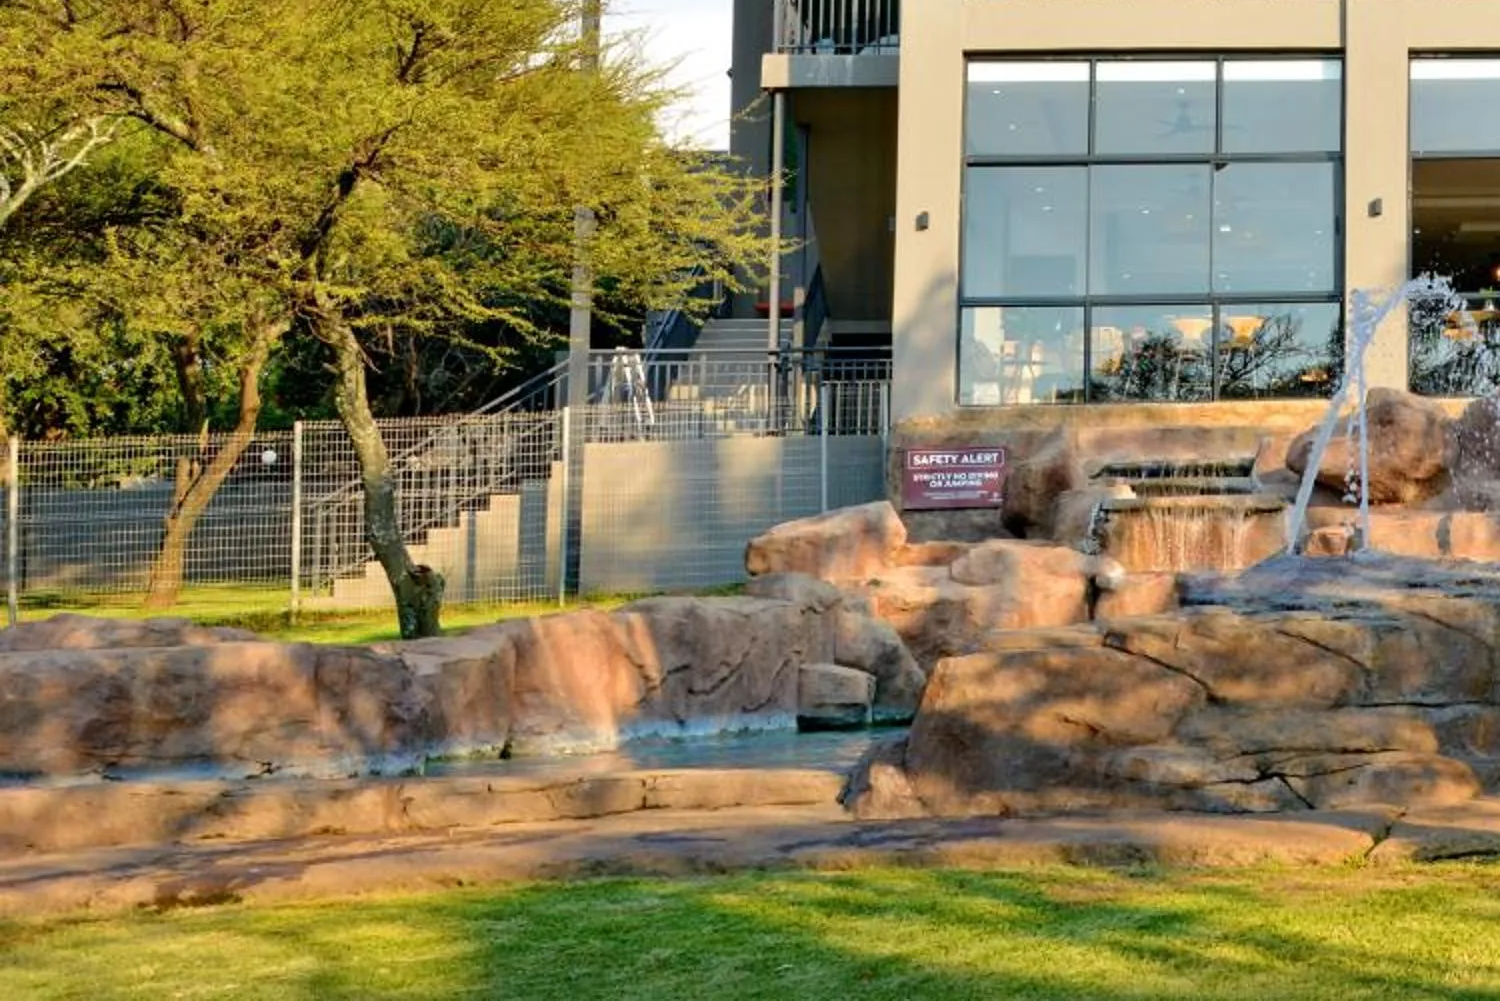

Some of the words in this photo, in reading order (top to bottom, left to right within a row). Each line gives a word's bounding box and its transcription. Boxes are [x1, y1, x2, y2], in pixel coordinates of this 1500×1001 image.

[913, 454, 958, 465] SAFETY
[961, 453, 999, 463] ALERT
[912, 472, 952, 482] STRICTLY
[953, 472, 966, 480] NO
